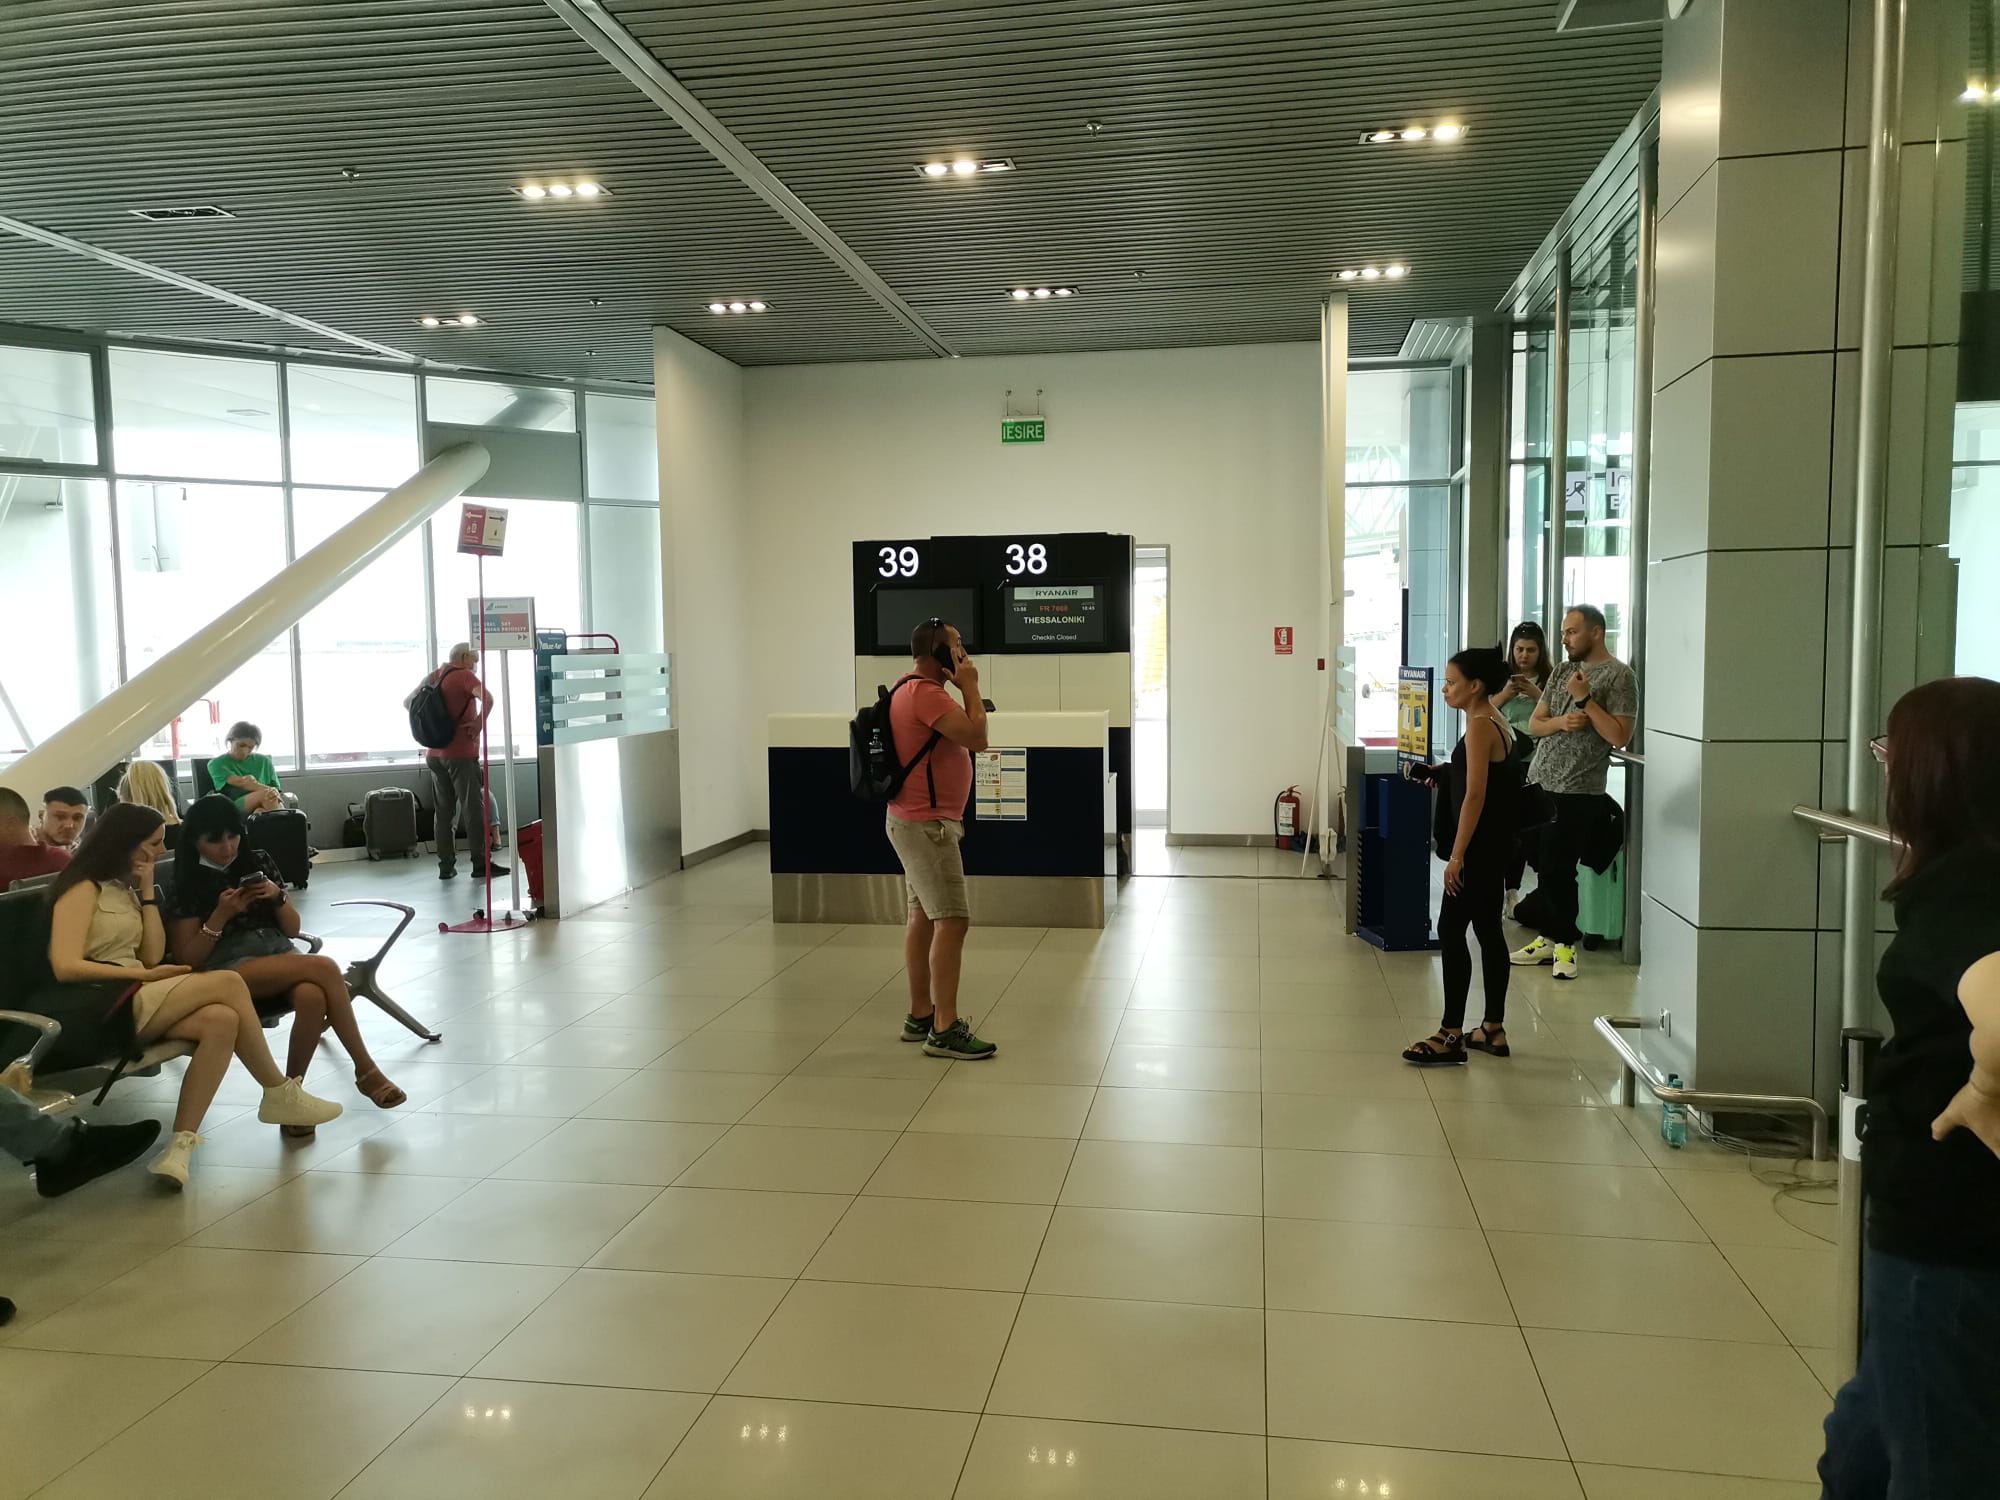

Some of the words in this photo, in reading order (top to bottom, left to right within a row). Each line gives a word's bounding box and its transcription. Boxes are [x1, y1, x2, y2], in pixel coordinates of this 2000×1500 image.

[878, 545, 920, 578] 39
[1005, 543, 1048, 576] 38
[1024, 616, 1085, 624] THESSALONIKI
[1403, 669, 1426, 679] RYANAIR
